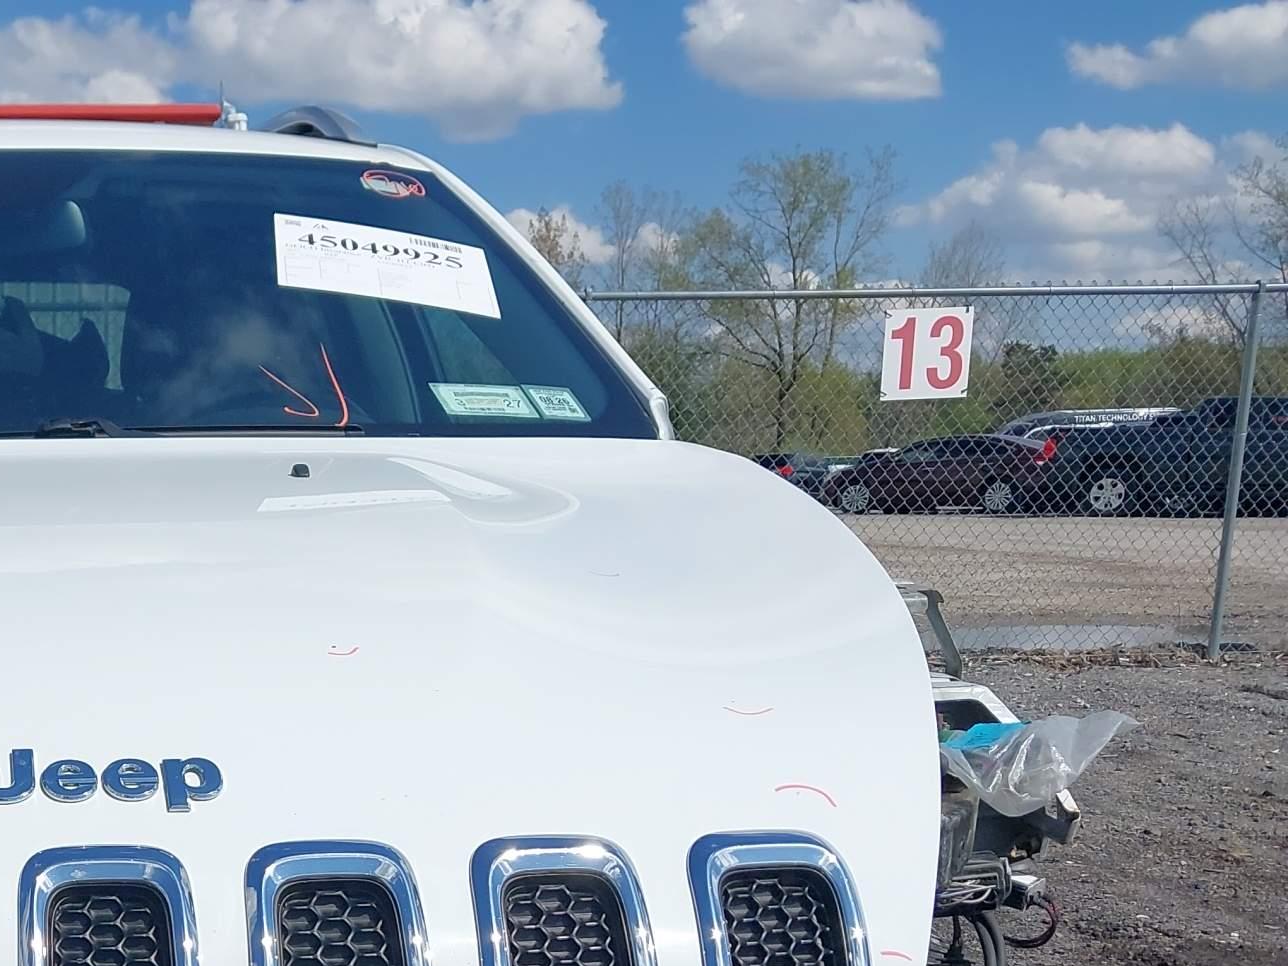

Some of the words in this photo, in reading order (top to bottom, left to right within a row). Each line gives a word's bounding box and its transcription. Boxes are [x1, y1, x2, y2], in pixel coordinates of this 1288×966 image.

[297, 232, 464, 270] 45049925
[891, 315, 964, 390] 13
[1073, 415, 1097, 423] TITAN
